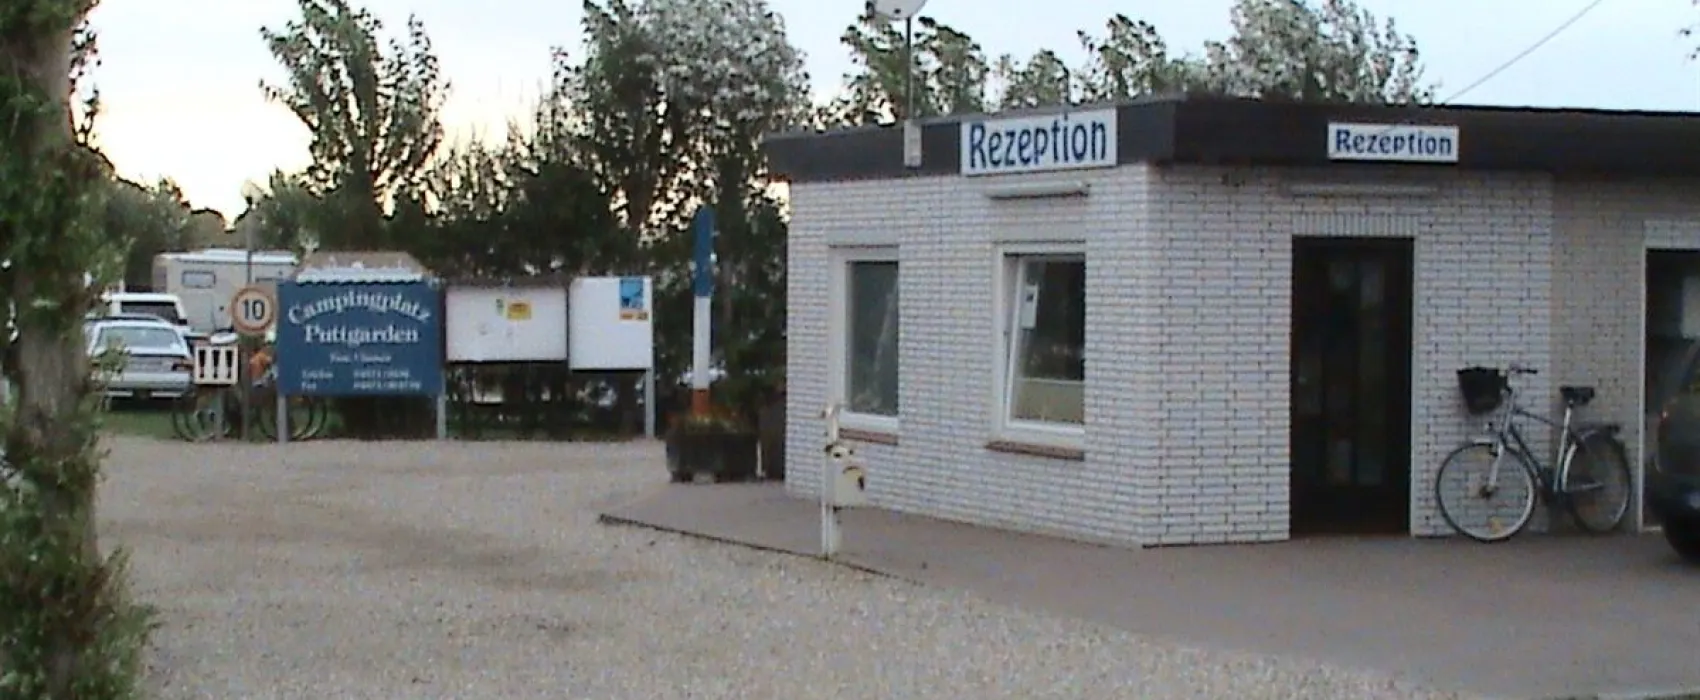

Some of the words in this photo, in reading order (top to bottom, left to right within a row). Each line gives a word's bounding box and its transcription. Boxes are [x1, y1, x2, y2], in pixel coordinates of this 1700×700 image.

[970, 114, 1106, 168] Rezeption
[1335, 129, 1452, 156] Rezeption
[242, 298, 265, 320] 10
[288, 289, 431, 325] Campingplatz
[304, 324, 419, 347] Puttgarden
